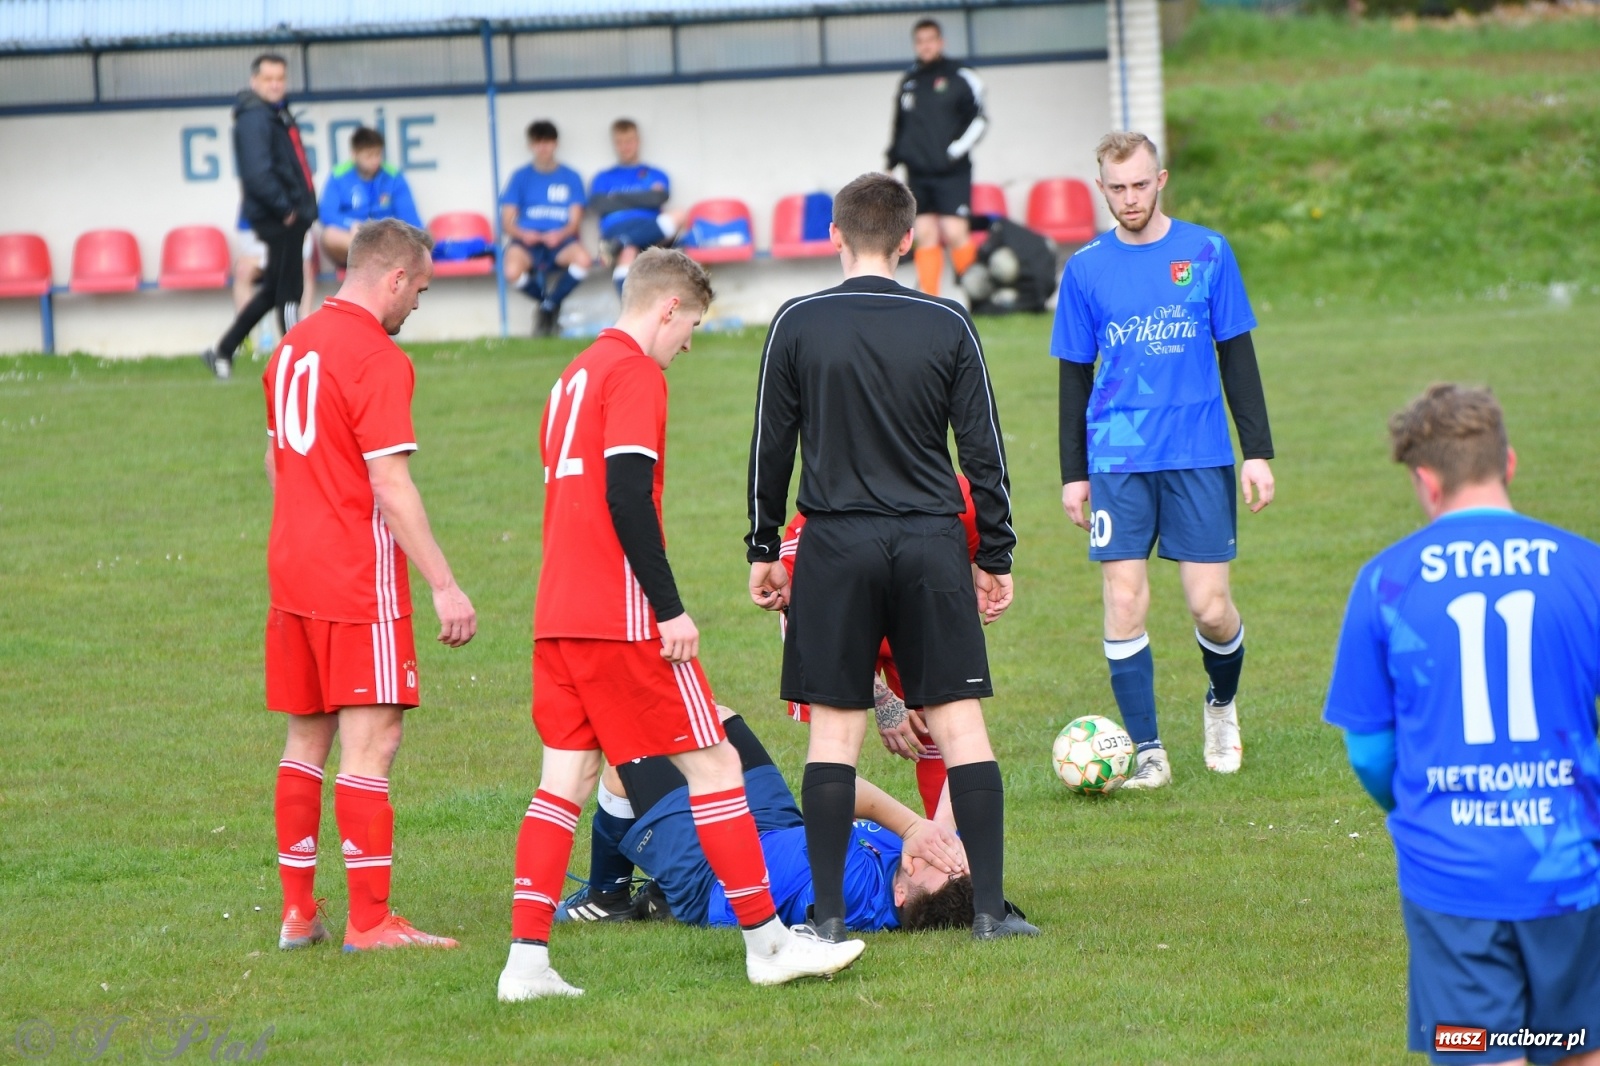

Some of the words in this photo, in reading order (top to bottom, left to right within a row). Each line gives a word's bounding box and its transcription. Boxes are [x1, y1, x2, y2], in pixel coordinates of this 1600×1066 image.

[181, 107, 438, 182] GCIE
[1105, 315, 1198, 348] Wiktoria
[1153, 304, 1187, 320] Willa
[275, 344, 320, 457] 10
[1420, 538, 1559, 583] START
[1446, 589, 1541, 745] 11
[1451, 797, 1556, 827] WIELKIE
